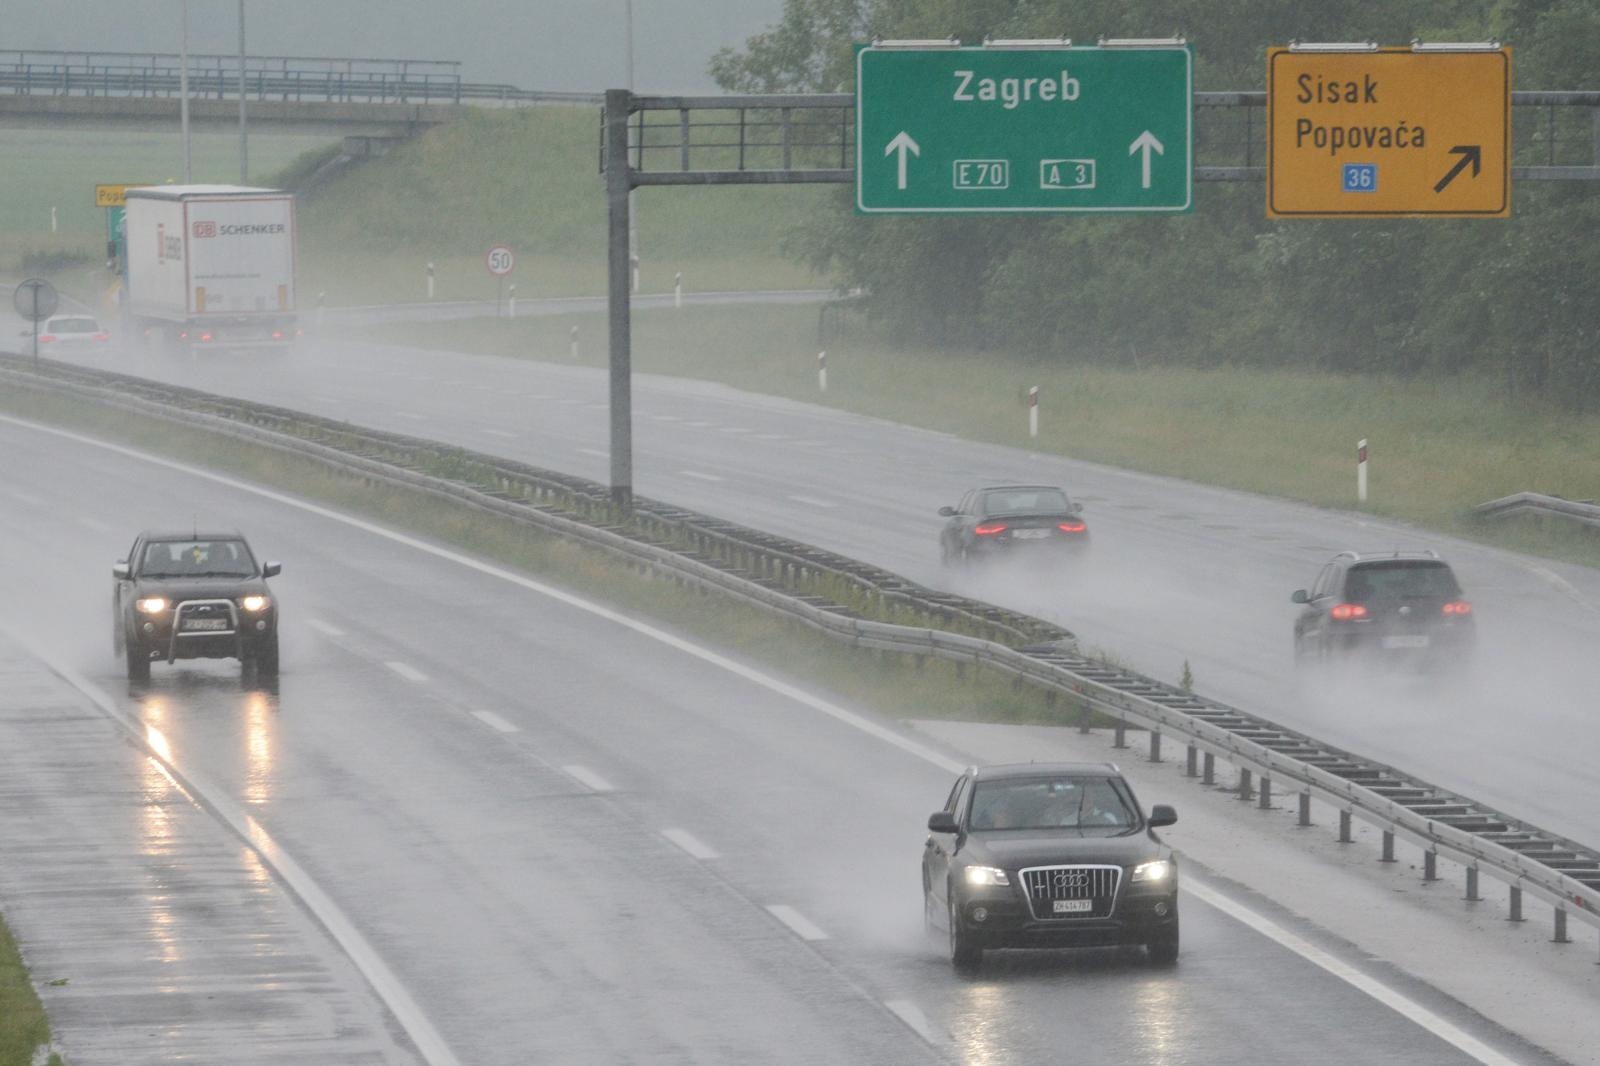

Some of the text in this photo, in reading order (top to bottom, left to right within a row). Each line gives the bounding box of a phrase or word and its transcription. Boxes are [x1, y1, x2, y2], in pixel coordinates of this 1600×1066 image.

[953, 70, 1080, 110] Zagreb
[1296, 73, 1378, 104] Sisak
[1296, 118, 1425, 156] Popovača
[959, 164, 1002, 185] E 70
[1049, 164, 1086, 185] A 3
[1347, 168, 1371, 188] 36
[219, 223, 285, 236] SCHENKER
[491, 252, 510, 270] 50
